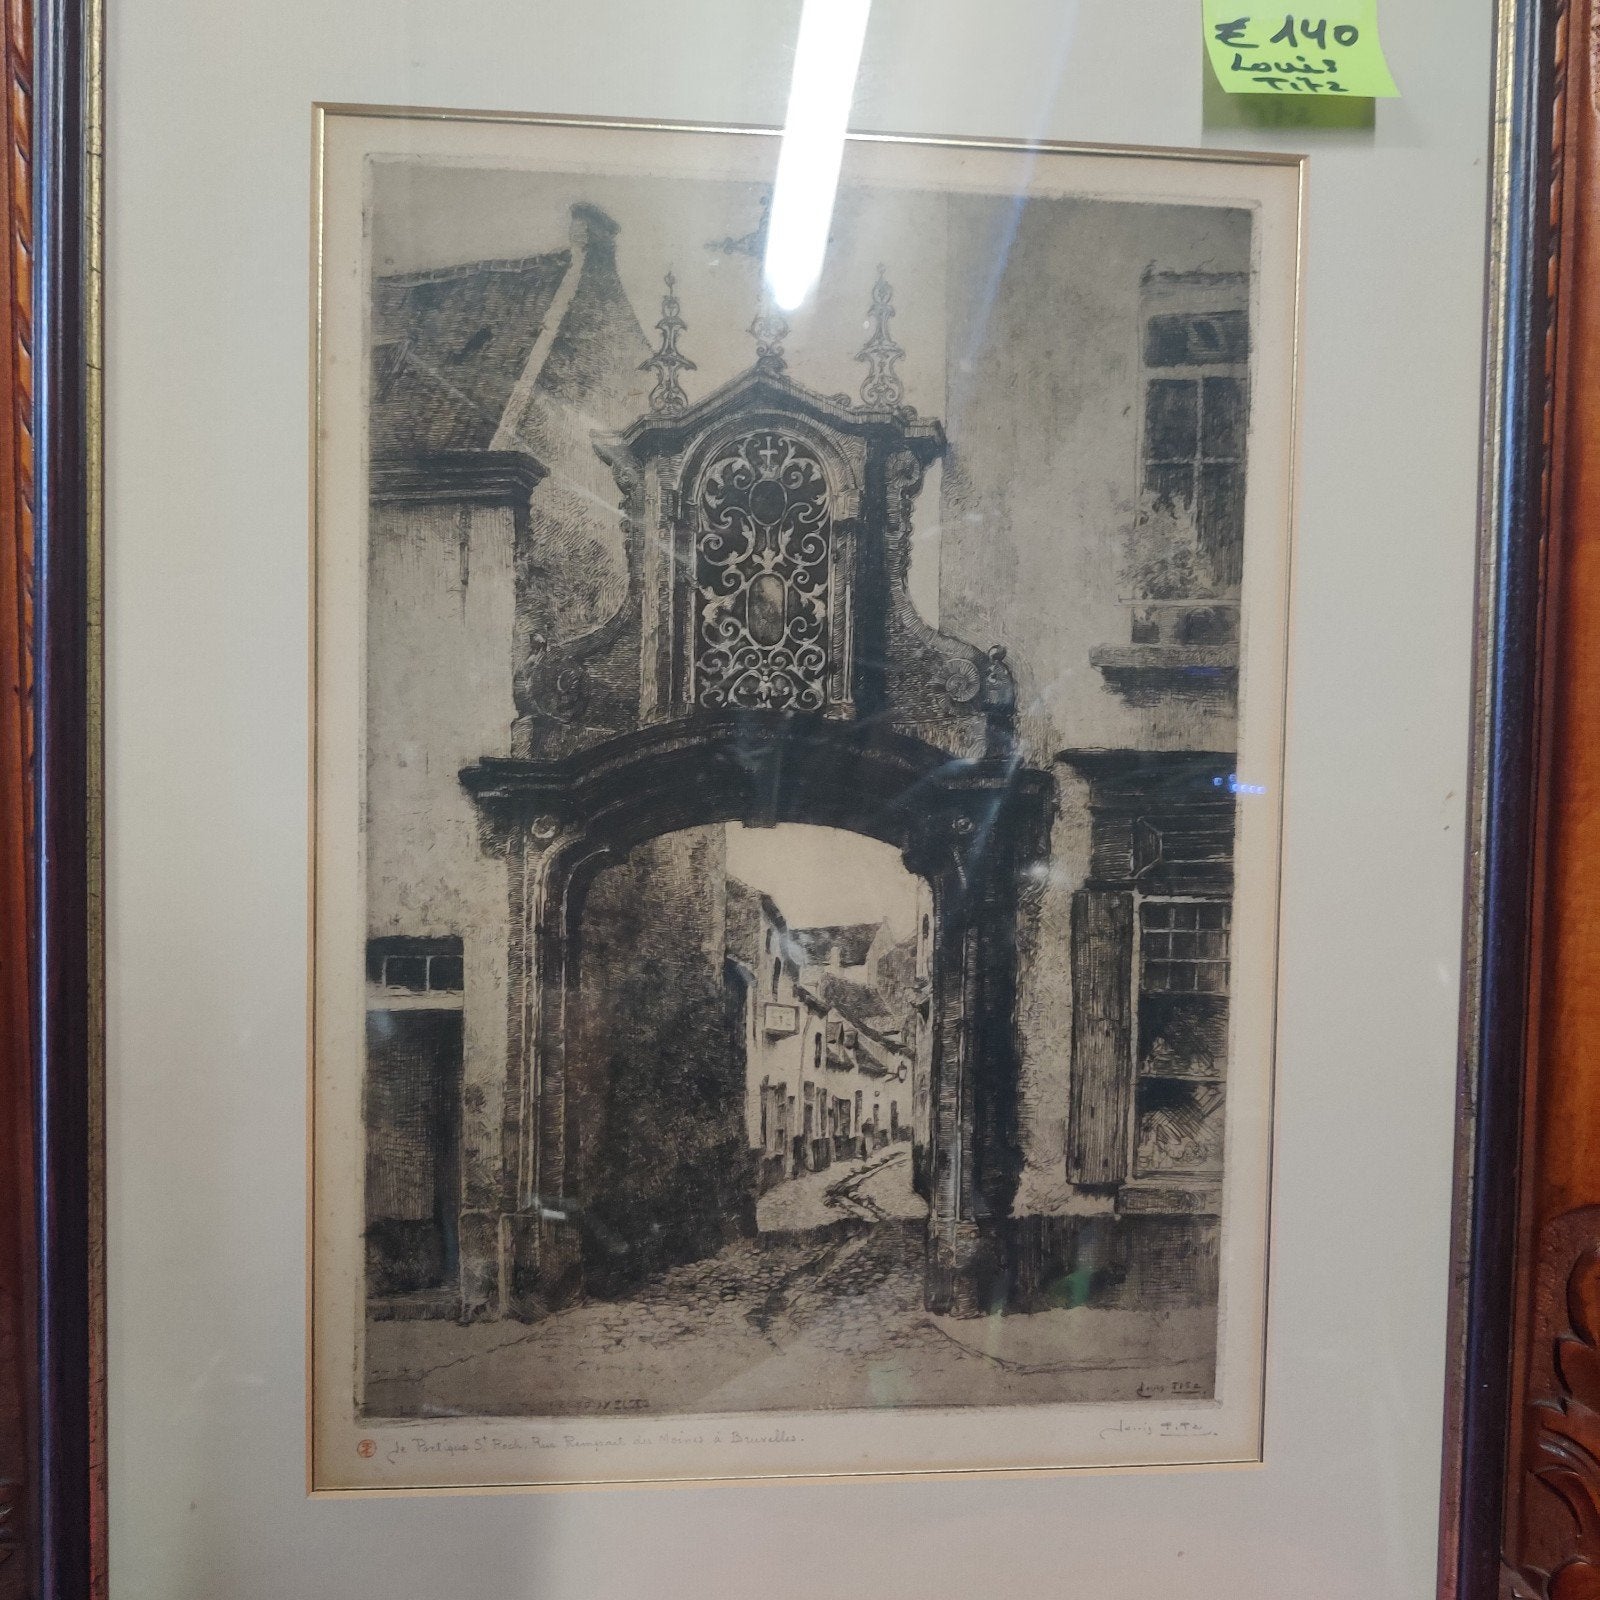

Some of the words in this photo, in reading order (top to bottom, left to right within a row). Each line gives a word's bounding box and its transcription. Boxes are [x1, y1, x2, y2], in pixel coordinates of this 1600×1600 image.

[1215, 17, 1259, 48] €
[1270, 15, 1358, 49] 140
[1231, 53, 1337, 73] Louis
